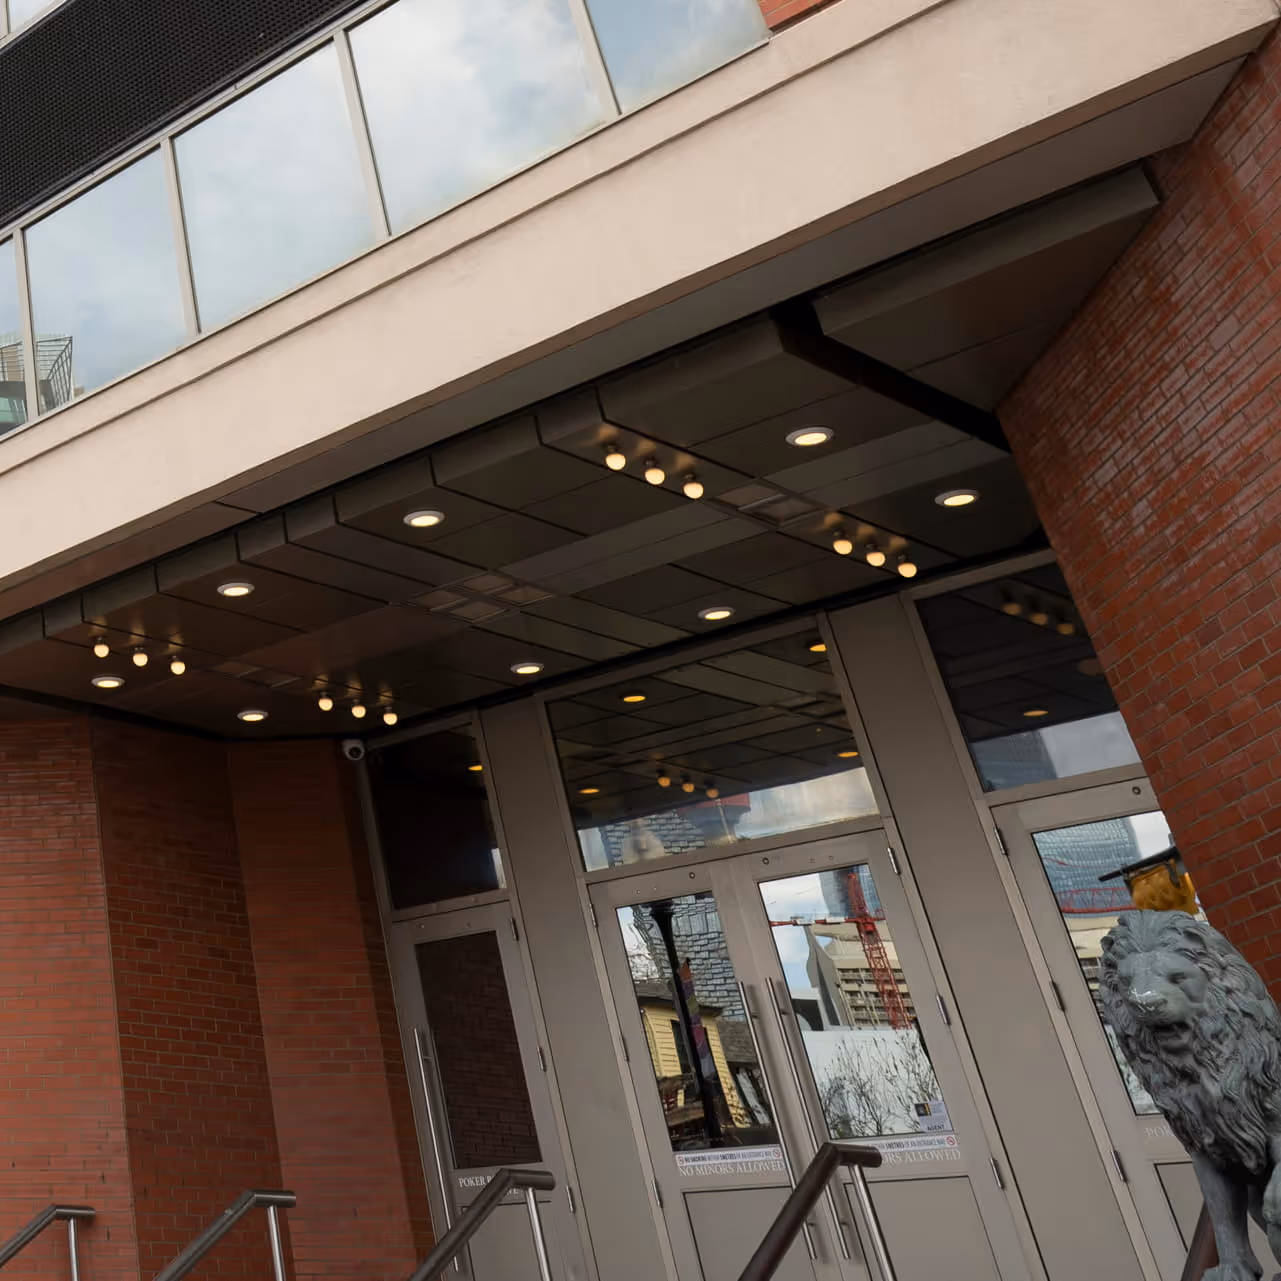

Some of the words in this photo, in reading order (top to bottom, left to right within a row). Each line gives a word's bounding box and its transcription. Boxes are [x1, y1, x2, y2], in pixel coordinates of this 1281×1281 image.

[903, 1148, 961, 1162] ALLOWED
[679, 1165, 694, 1177] NO
[695, 1163, 735, 1176] MINORS
[736, 1160, 786, 1174] ALLOWED
[458, 1176, 487, 1188] POKER
